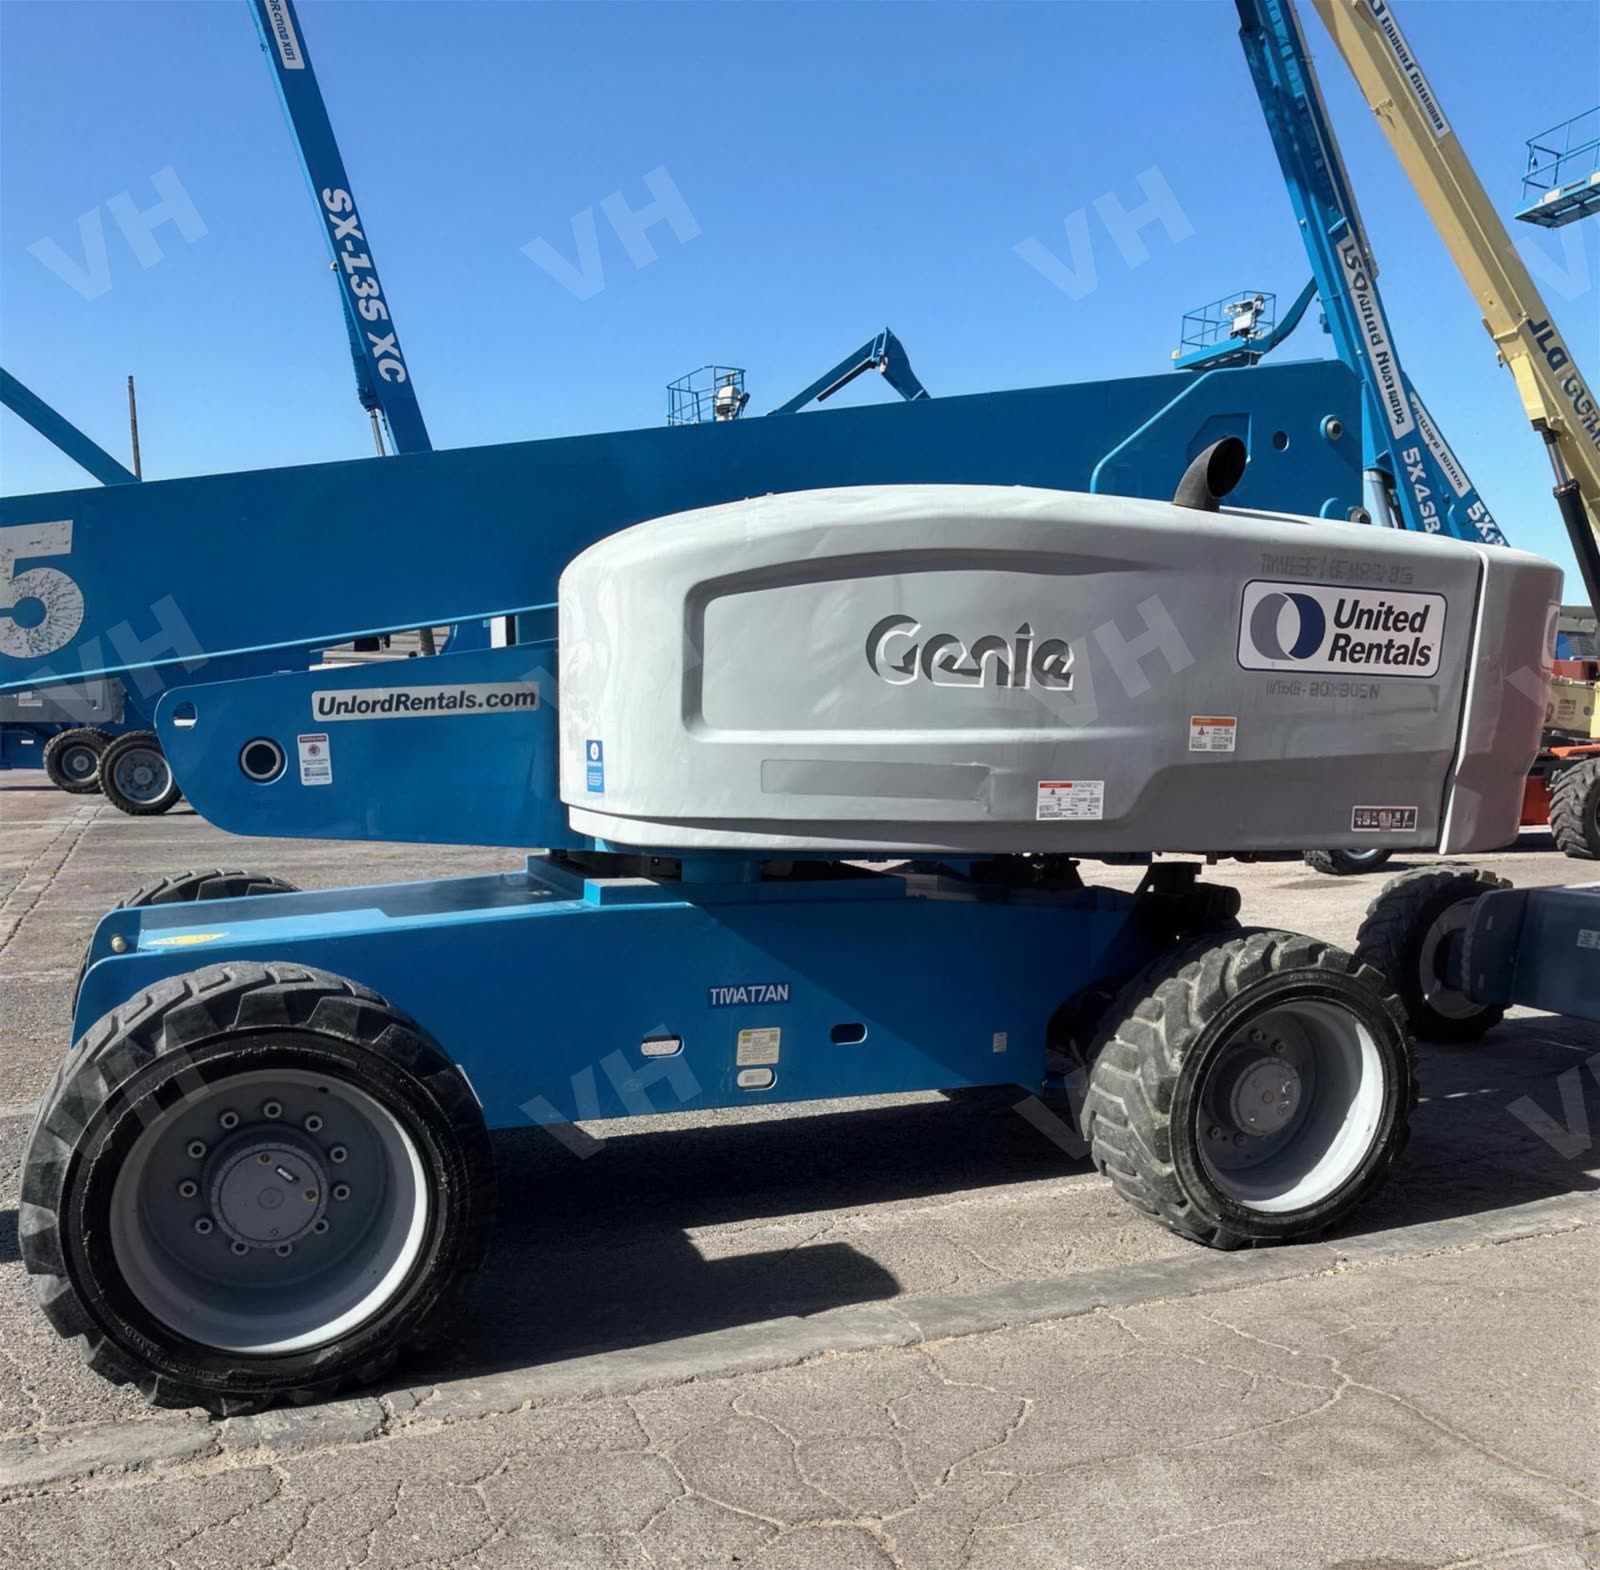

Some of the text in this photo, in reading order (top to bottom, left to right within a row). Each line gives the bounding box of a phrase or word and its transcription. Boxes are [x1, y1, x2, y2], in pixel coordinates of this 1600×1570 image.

[367, 332, 406, 383] XC
[1334, 598, 1430, 633] United
[866, 614, 1074, 690] Genie
[1328, 633, 1431, 667] Rentals
